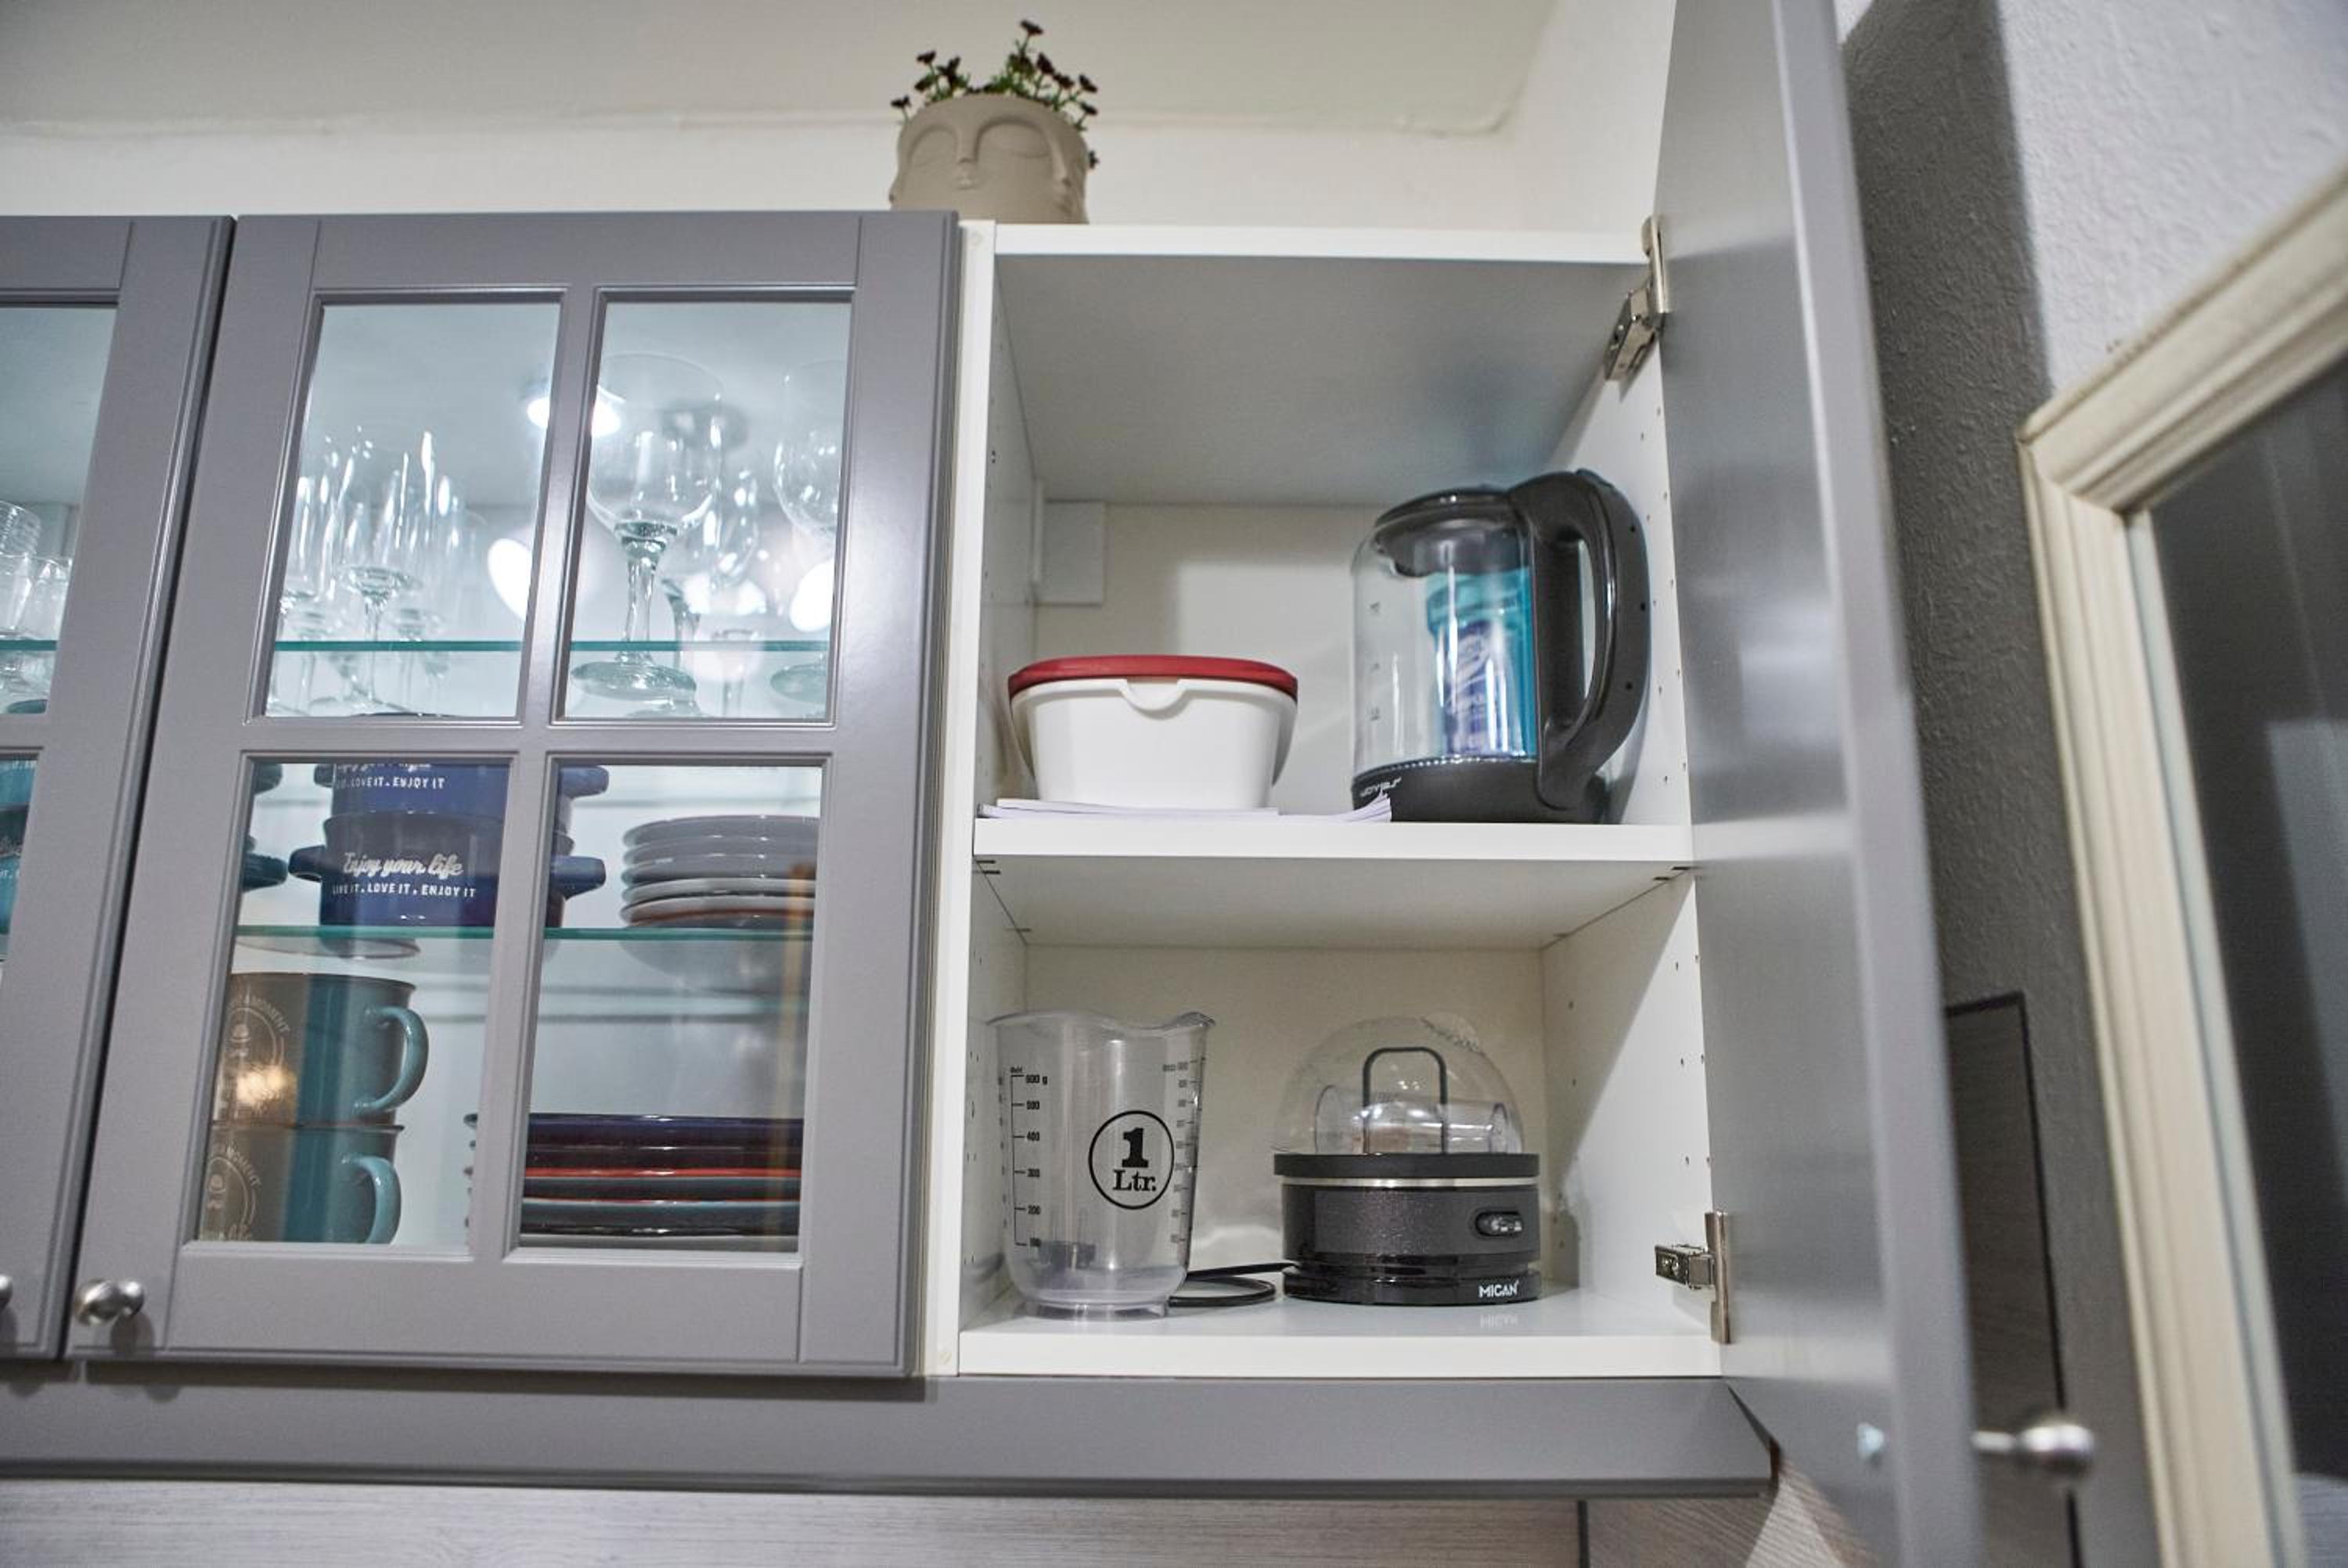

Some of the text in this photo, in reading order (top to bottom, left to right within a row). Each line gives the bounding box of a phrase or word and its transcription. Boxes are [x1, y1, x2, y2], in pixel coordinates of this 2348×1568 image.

[392, 776, 429, 789] ENJOY
[432, 777, 445, 789] IT
[380, 858, 427, 877] your
[427, 853, 464, 880] life
[367, 883, 395, 894] LOVE
[421, 884, 462, 897] ENJOY
[464, 888, 477, 897] IT
[1122, 1127, 1149, 1167] 1
[1112, 1169, 1157, 1192] Ltr.
